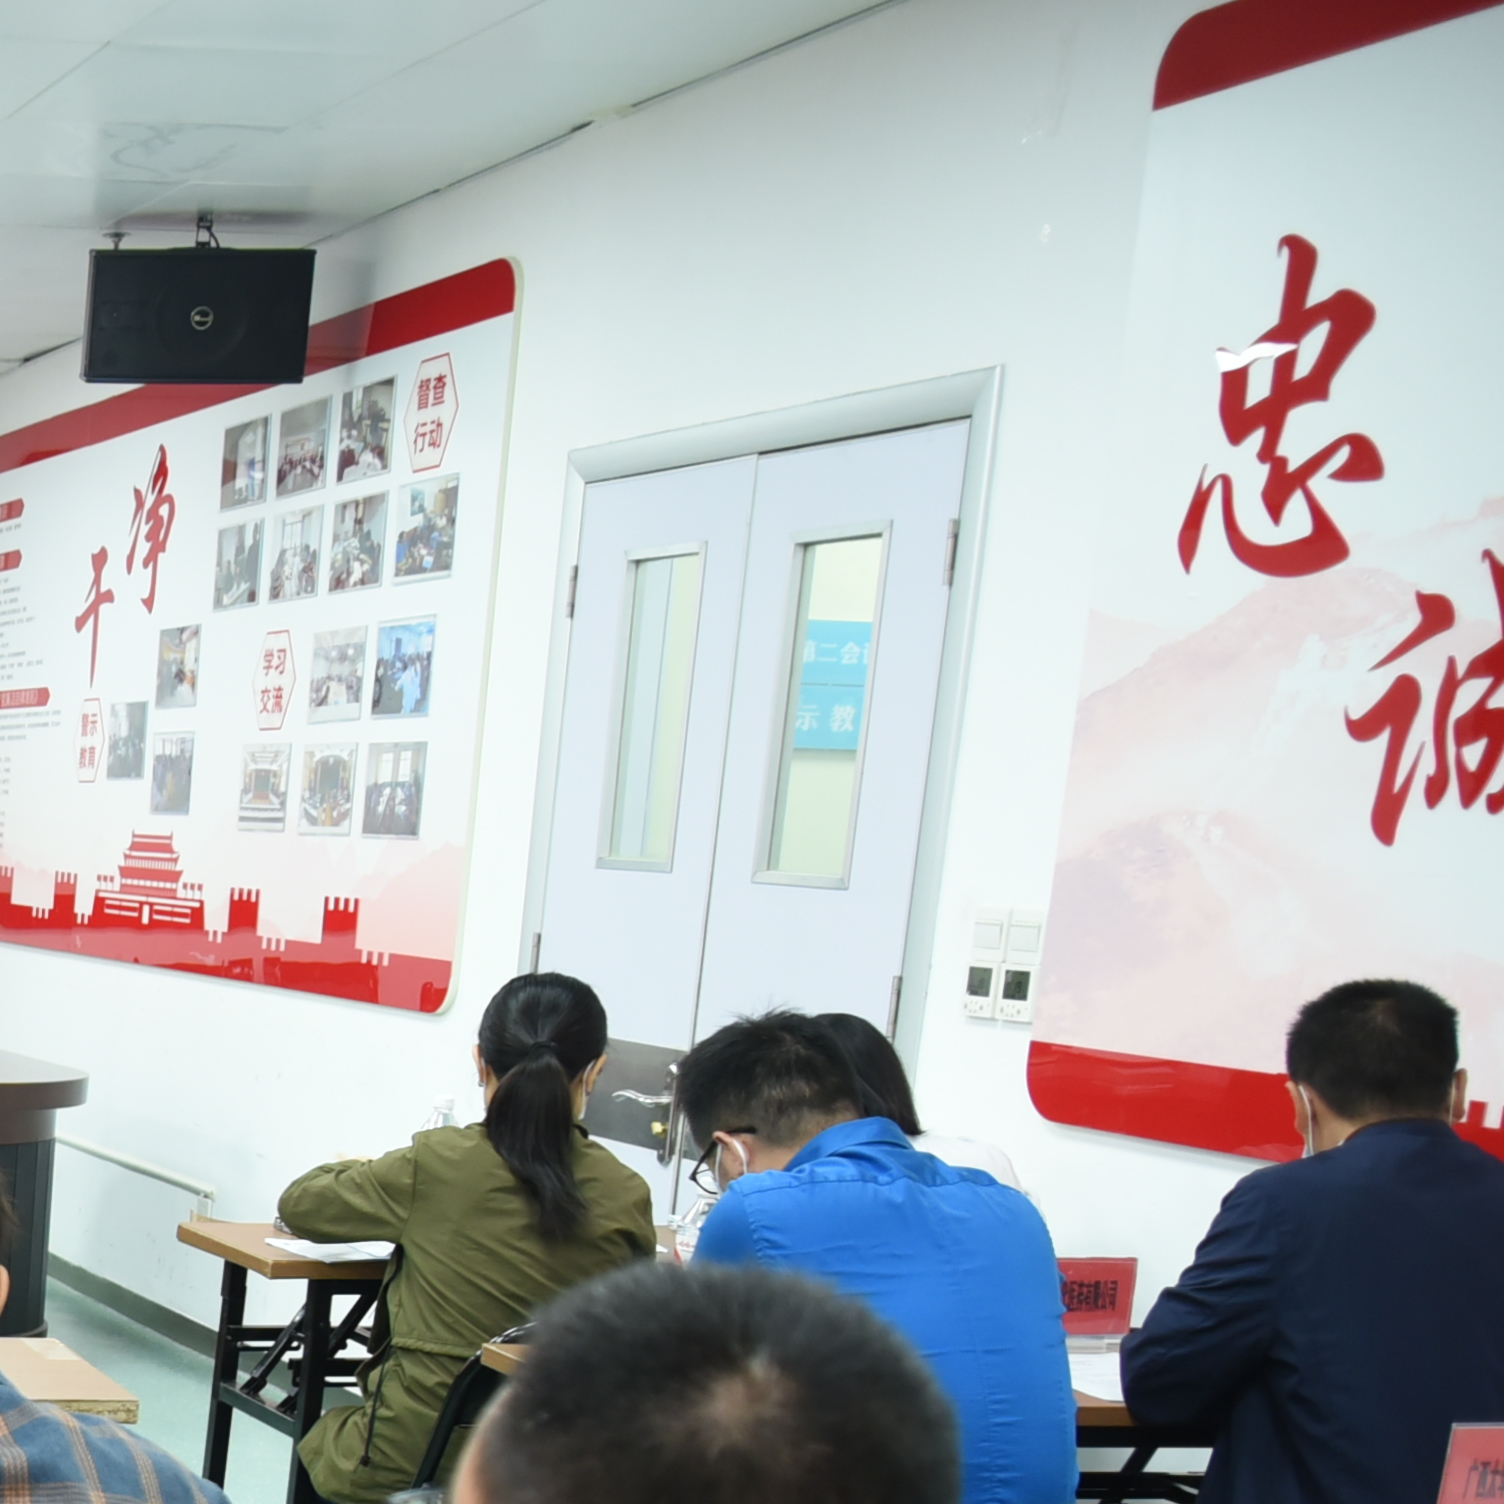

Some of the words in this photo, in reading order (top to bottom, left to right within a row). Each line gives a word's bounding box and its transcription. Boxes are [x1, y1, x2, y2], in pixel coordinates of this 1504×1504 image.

[417, 374, 448, 410] 督查
[413, 417, 445, 454] 行动
[262, 646, 288, 677] 学习
[258, 684, 285, 715] 交流
